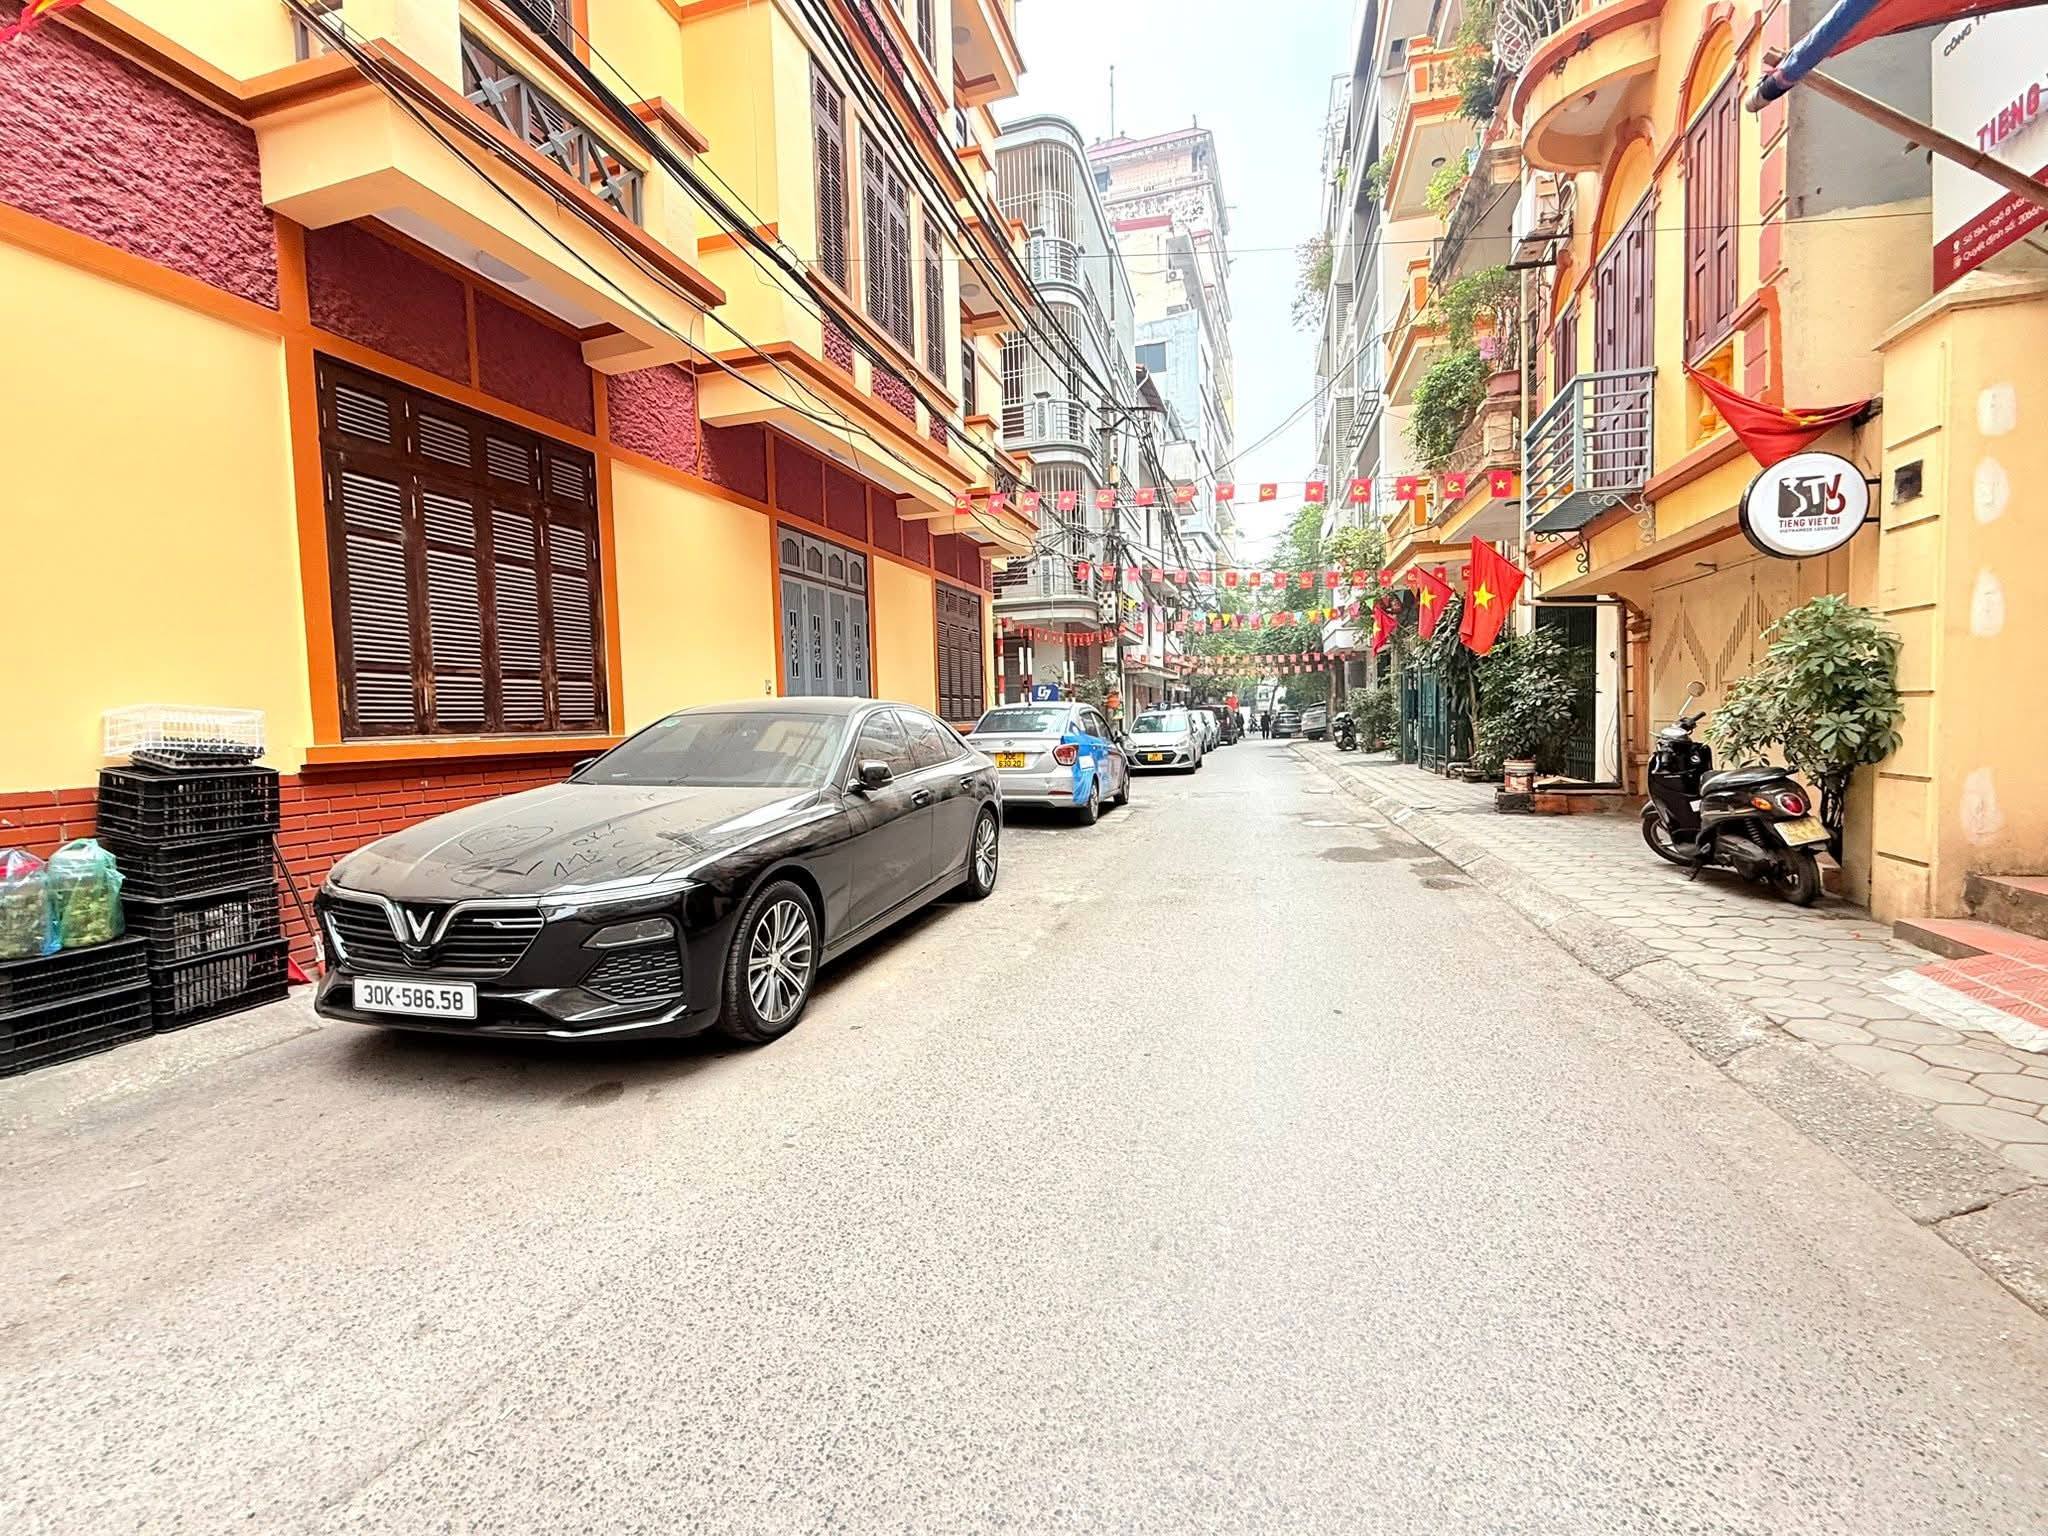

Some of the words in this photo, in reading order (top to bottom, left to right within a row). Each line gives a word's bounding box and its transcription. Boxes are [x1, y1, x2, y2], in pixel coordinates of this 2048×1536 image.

[1779, 518, 1806, 528] TIENG
[1807, 517, 1828, 527] VIET
[363, 985, 464, 1010] 30K-586.58
